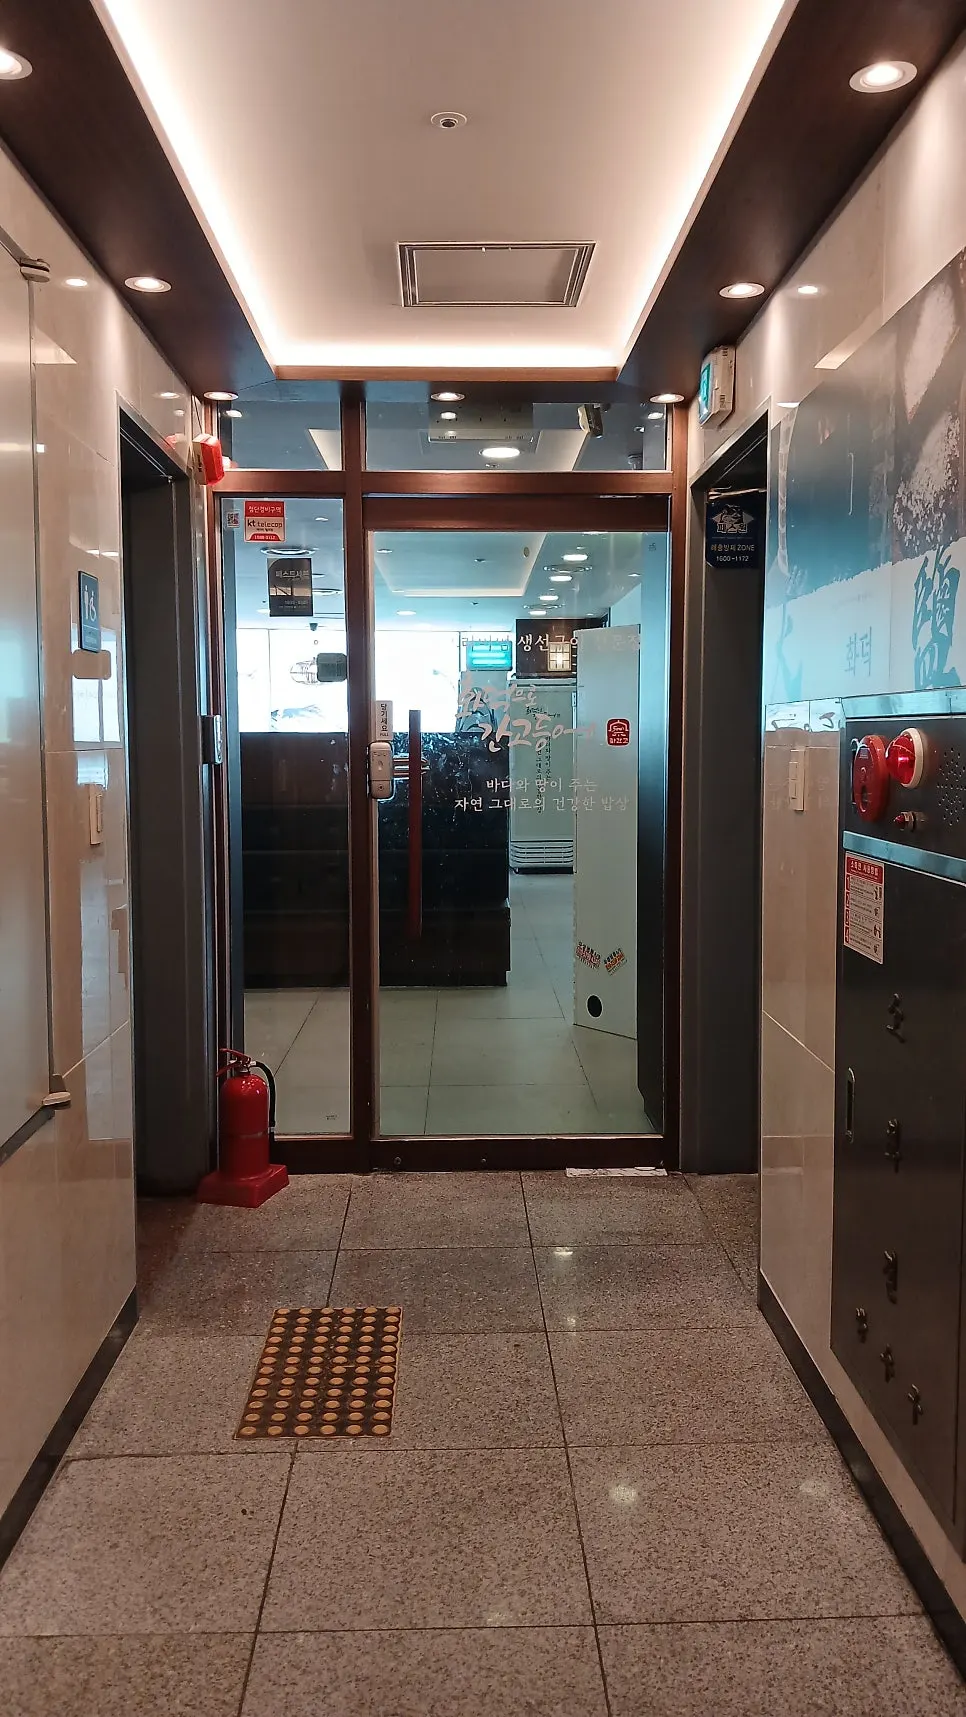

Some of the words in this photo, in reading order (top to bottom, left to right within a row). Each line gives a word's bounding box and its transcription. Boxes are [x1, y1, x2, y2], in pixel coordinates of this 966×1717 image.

[247, 519, 256, 527] kt
[257, 520, 283, 528] telecop
[845, 626, 873, 677] 화덕
[380, 703, 388, 731] 당기세요
[478, 714, 597, 753] 간고등어
[486, 778, 530, 793] 바다와
[535, 778, 562, 793] 땅이
[568, 778, 598, 792] 주는
[454, 797, 483, 812] 자연
[488, 797, 546, 812] 그대로의
[552, 797, 596, 812] 건강한
[600, 796, 630, 812] 밥상
